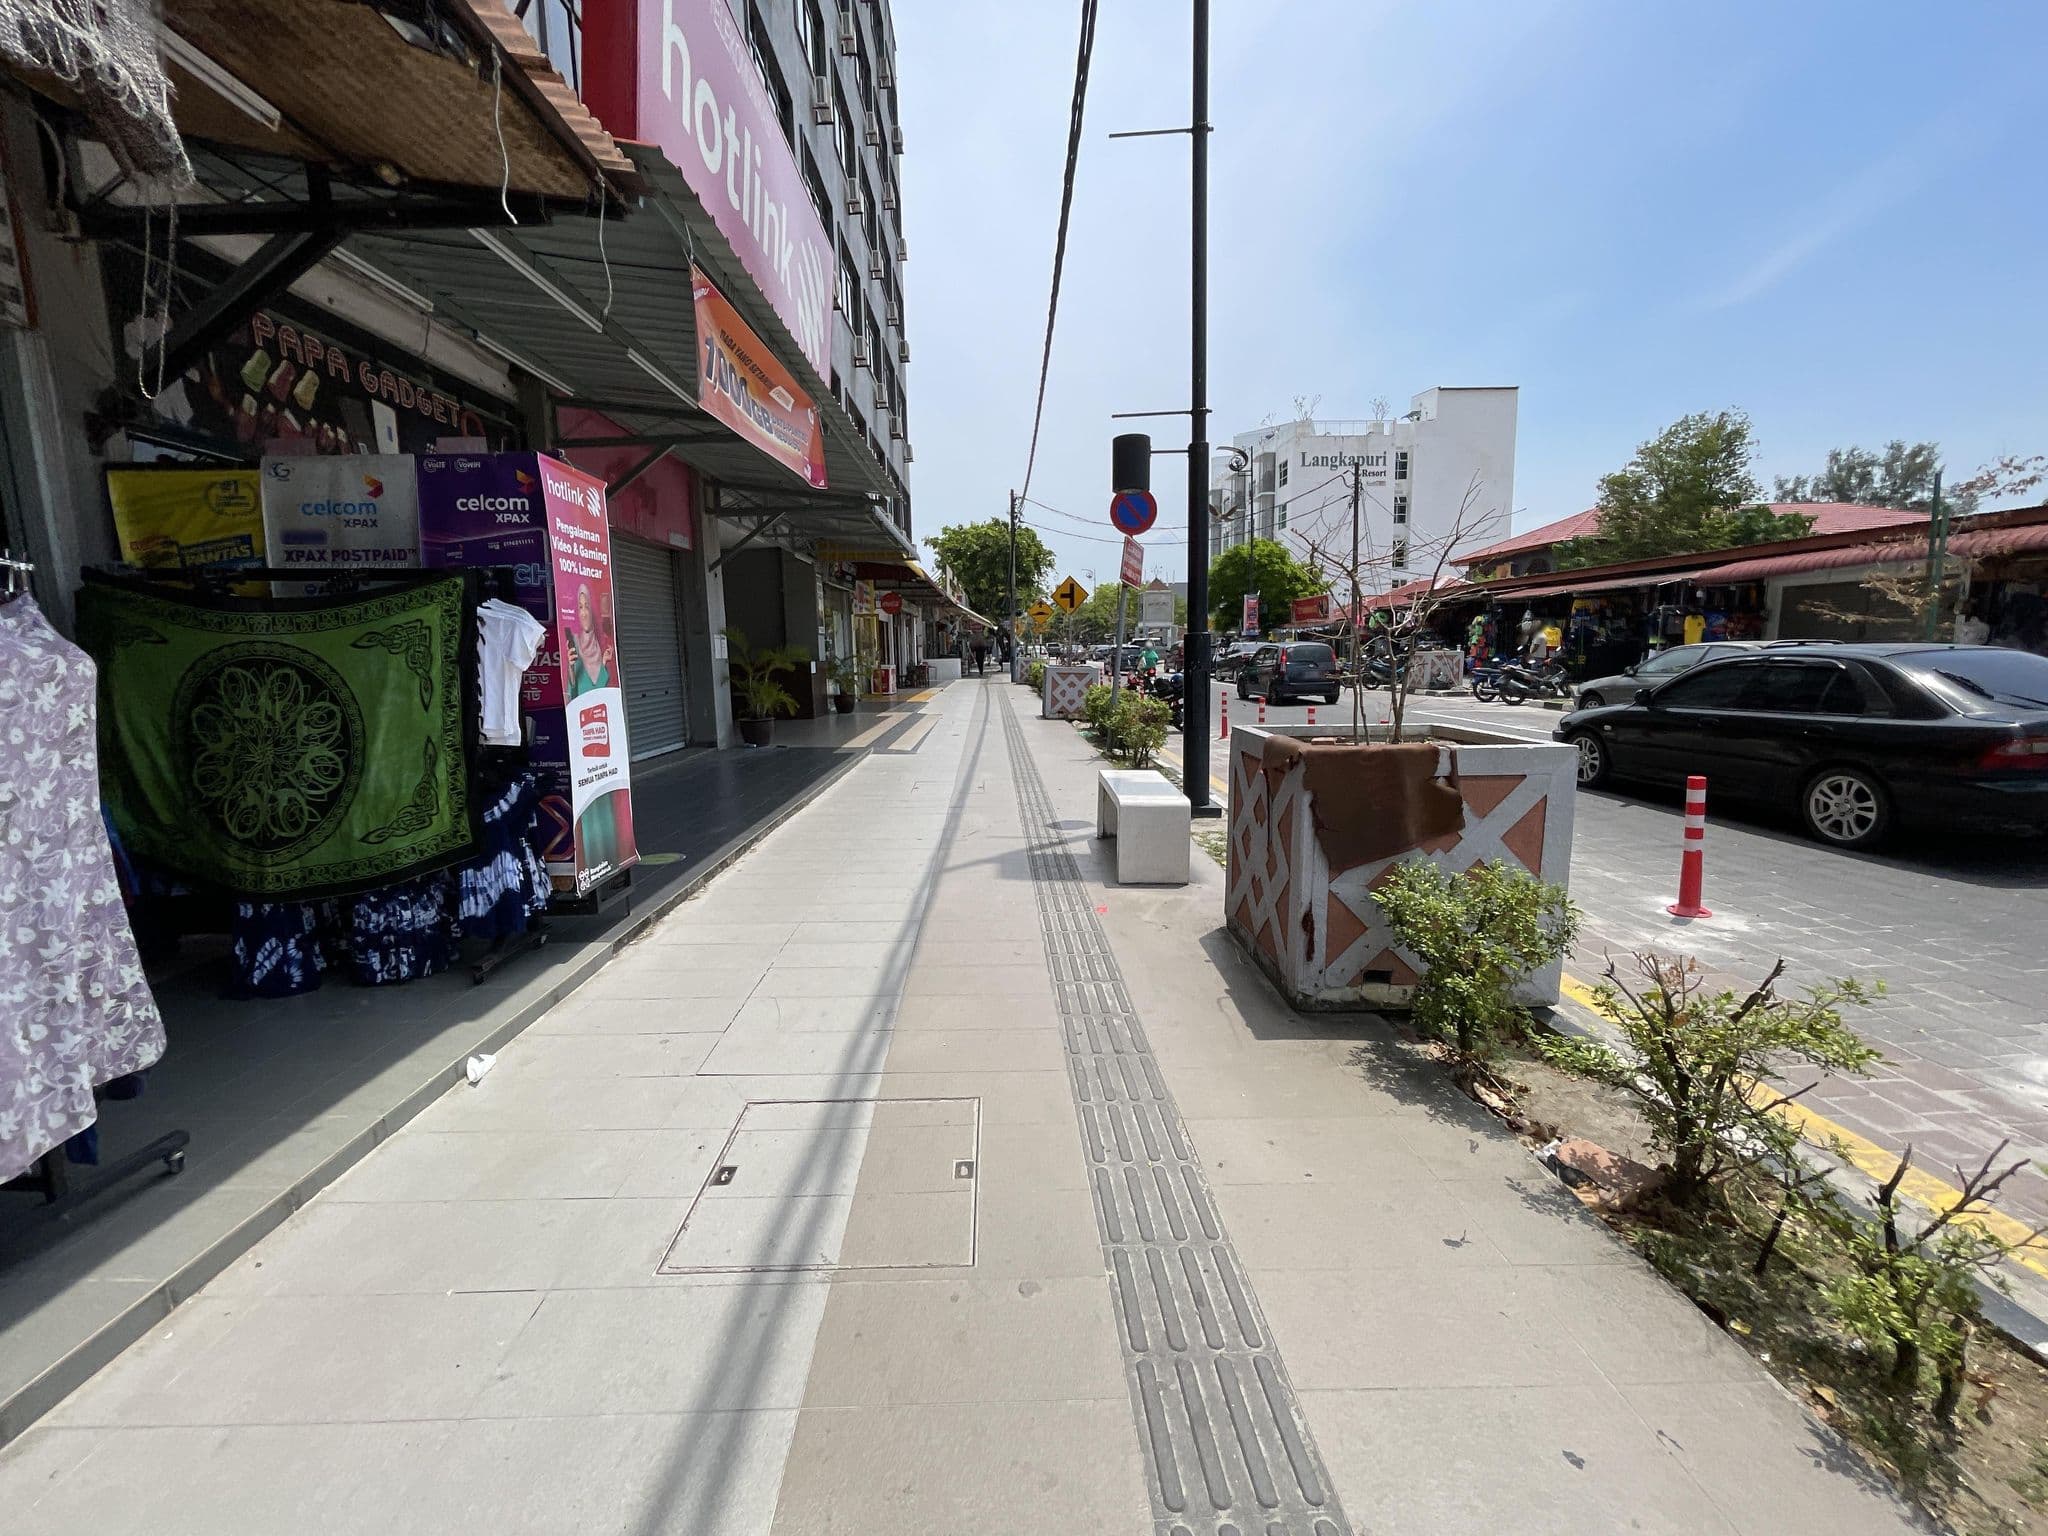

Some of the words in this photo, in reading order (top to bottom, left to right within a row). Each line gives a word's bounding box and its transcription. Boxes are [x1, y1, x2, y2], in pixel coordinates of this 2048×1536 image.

[662, 0, 794, 300] hotlink
[252, 311, 350, 383] PAPA
[359, 361, 460, 428] GADGET
[1300, 450, 1387, 471] Langkapuri
[1362, 469, 1386, 477] Resort
[546, 473, 584, 507] hotlink
[301, 499, 377, 516] celcom
[456, 493, 529, 511] celcom
[343, 518, 378, 528] XPAX
[495, 513, 530, 523] XPAX
[555, 517, 600, 543] Pengalaman
[285, 549, 329, 562] XPAX
[551, 535, 572, 554] Video
[573, 542, 579, 556] &
[579, 543, 608, 566] Gaming
[559, 557, 578, 574] 100%
[578, 562, 602, 579] Lancar
